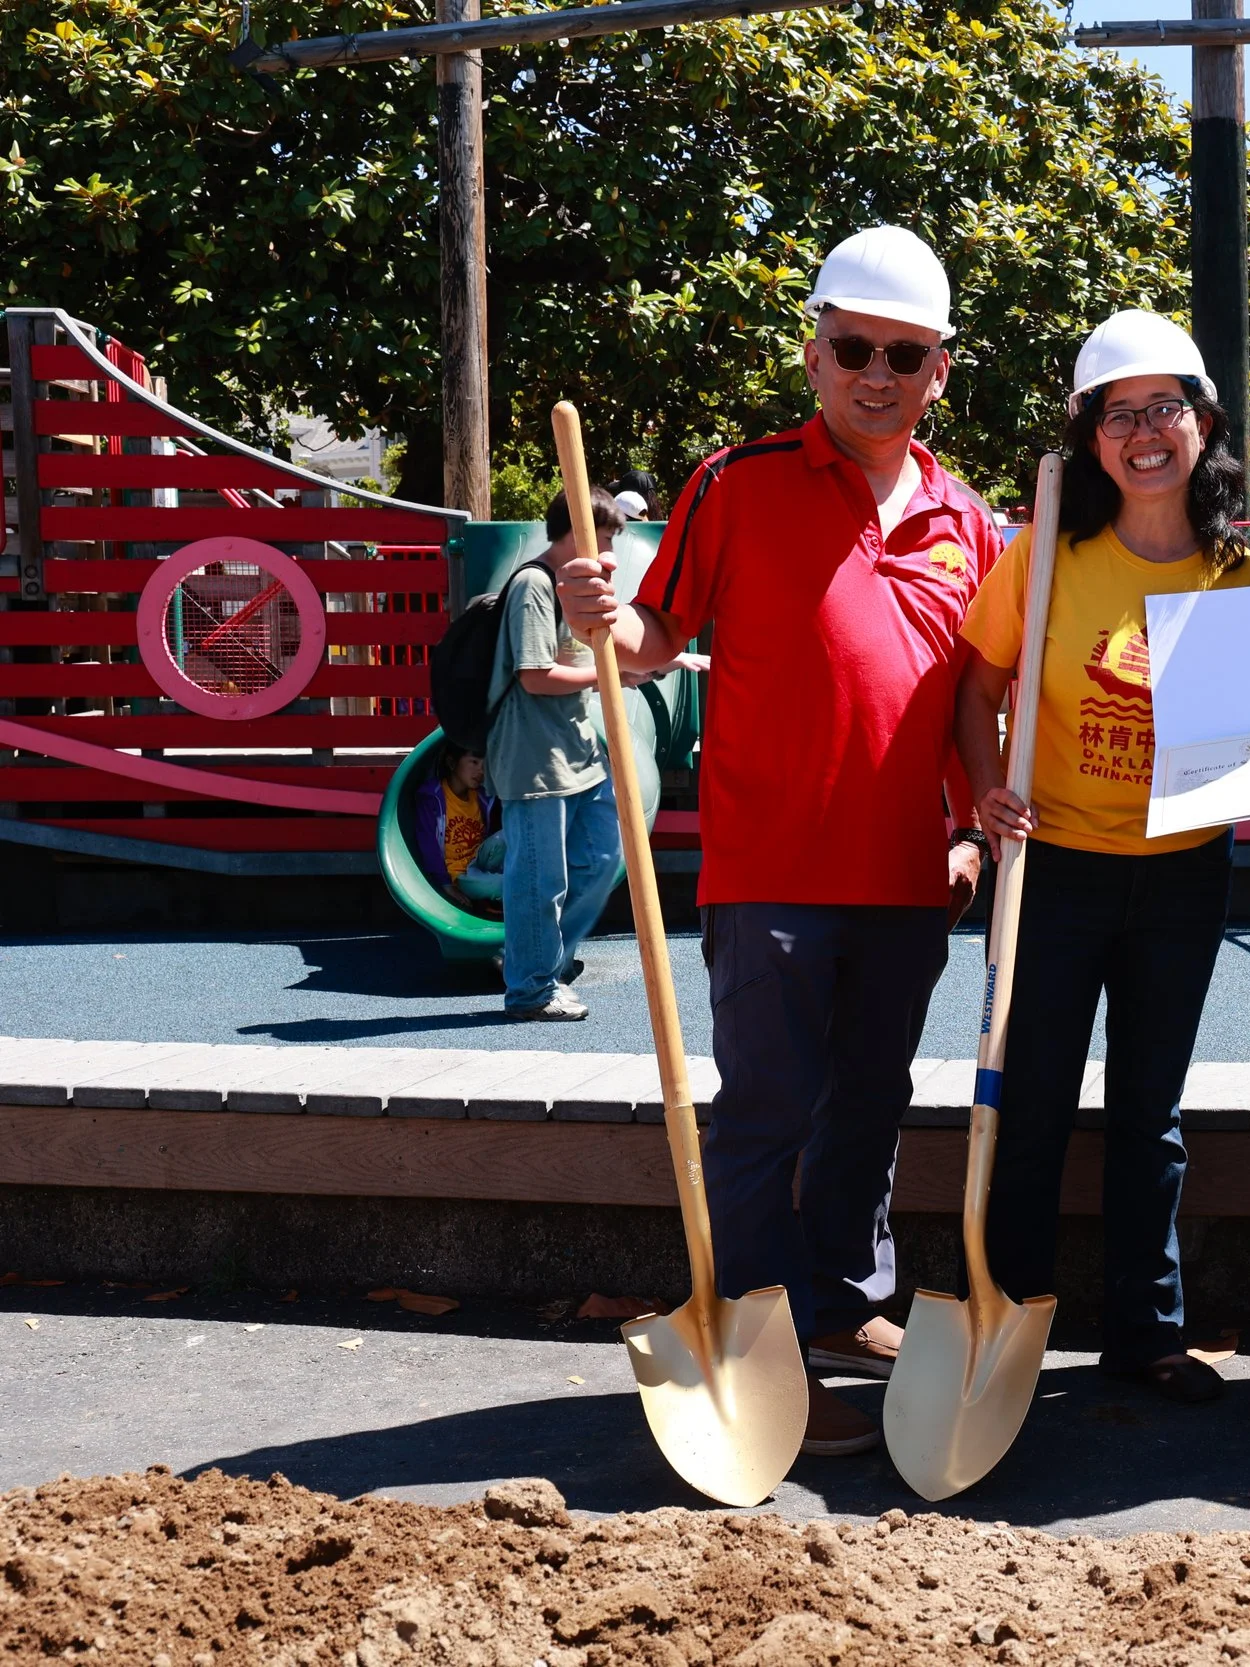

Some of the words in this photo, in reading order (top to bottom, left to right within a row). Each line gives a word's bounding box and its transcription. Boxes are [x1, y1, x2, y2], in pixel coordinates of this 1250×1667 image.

[1079, 722, 1155, 754] 林肯中
[1083, 748, 1153, 770] OAKLA
[1079, 763, 1153, 786] CHINATO
[980, 963, 997, 1034] WESTWARD
